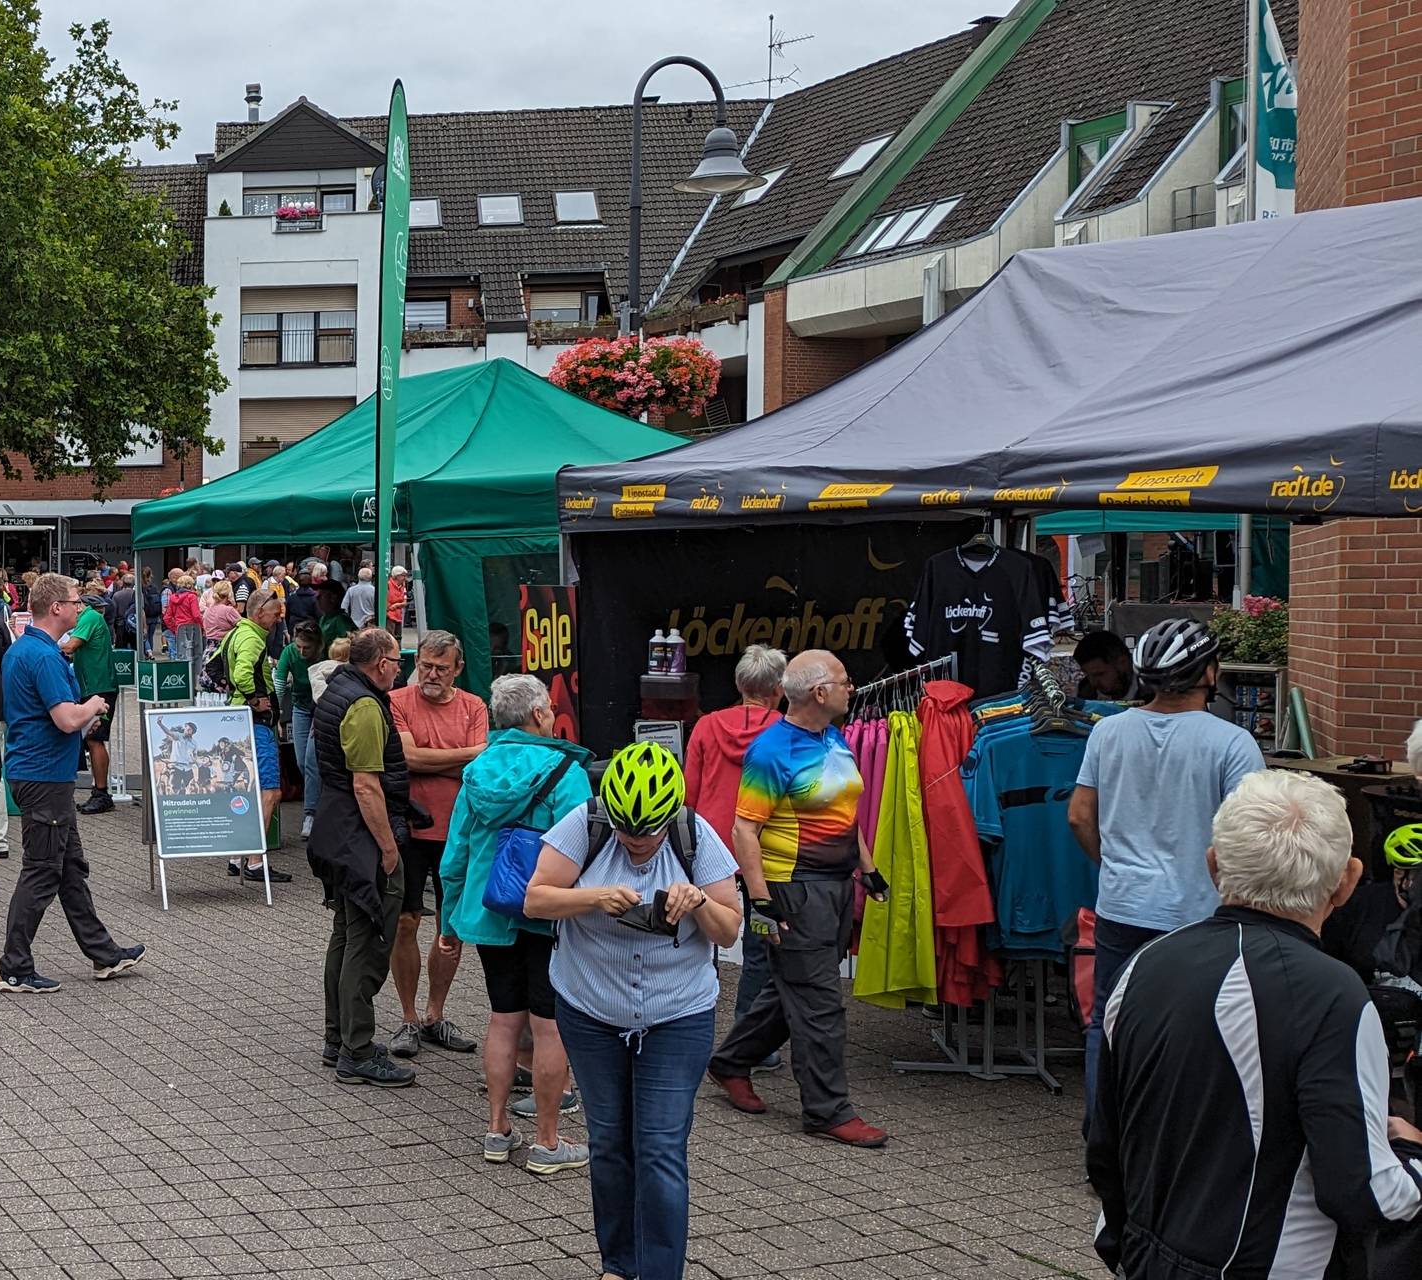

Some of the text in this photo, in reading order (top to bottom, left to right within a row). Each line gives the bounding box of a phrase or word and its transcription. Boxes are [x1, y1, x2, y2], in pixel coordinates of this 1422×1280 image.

[1132, 471, 1205, 487] Lippstadt
[1271, 474, 1334, 497] rad1.de
[628, 487, 660, 499] Lippstadt
[741, 495, 781, 509] Löckenhoff
[945, 605, 988, 619] Löckenhoff
[526, 602, 572, 672] Sale
[140, 674, 153, 686] AOK
[162, 674, 186, 686] AOK
[163, 808, 199, 817] gewinnen!
